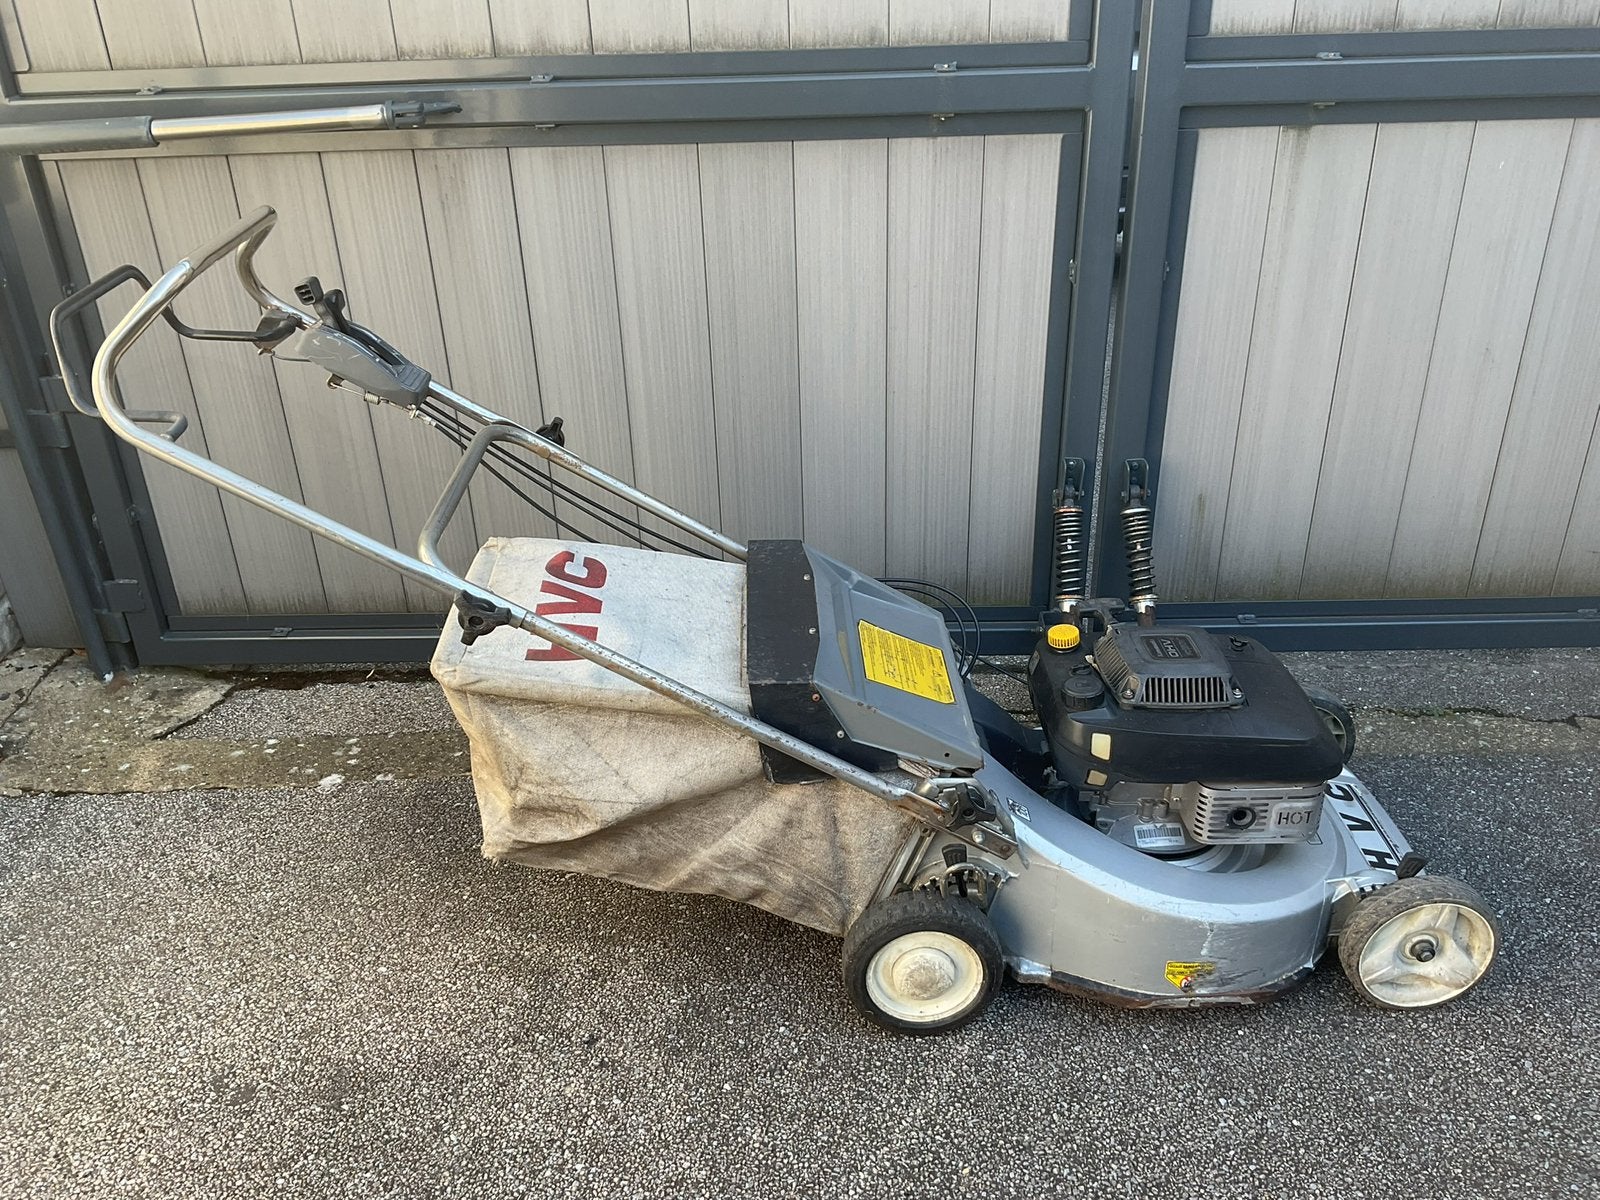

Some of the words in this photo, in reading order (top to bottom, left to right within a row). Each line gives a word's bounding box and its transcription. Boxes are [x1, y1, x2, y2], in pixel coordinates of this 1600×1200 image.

[1161, 638, 1179, 658] OHV
[1277, 811, 1313, 825] HOT
[1324, 783, 1400, 871] HVC
